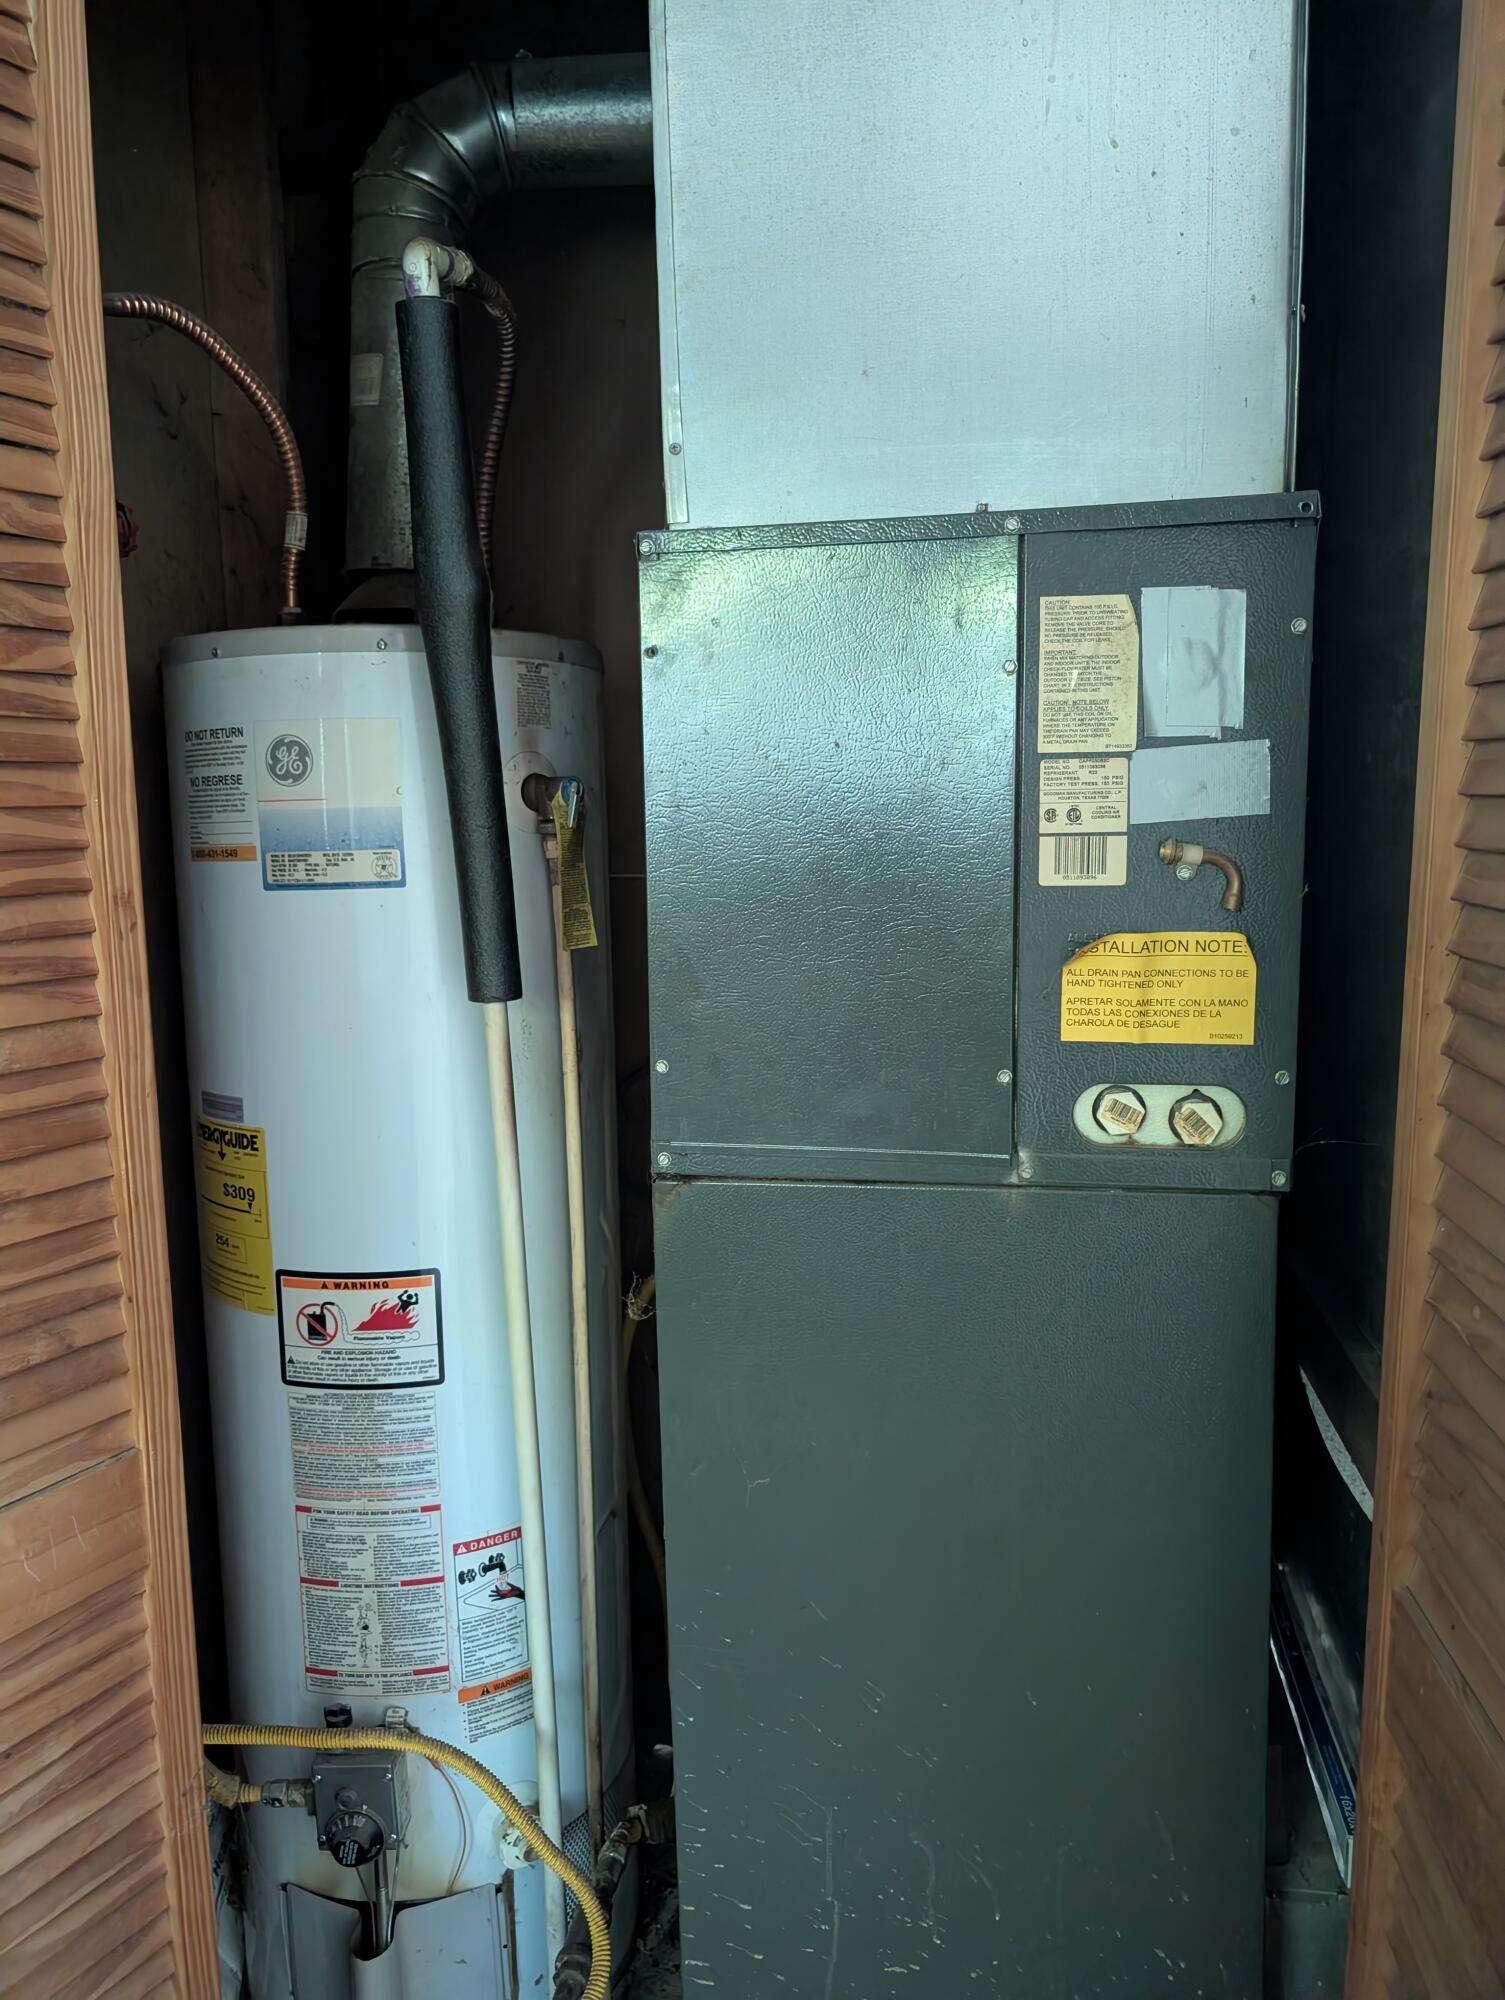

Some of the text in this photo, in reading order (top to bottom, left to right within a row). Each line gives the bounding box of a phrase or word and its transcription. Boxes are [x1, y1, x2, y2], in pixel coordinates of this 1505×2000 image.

[185, 727, 244, 742] DO NOT RETURN
[190, 774, 243, 788] NO REGRESE
[1083, 939, 1189, 955] STALLATION
[1196, 939, 1248, 954] NOTE:
[1066, 968, 1085, 977] ALL
[1088, 968, 1119, 977] DRAIN
[1122, 970, 1141, 978] PAN
[1143, 969, 1216, 978] CONNECTIONS
[1220, 969, 1232, 977] TO
[1067, 979, 1184, 989] HAND TIGHTENED ONLY
[1066, 997, 1248, 1008] APRETAR SOLAMENTE CON LA MANO
[1067, 1008, 1222, 1018] TODAS LAS CONEXIONES DE LA
[1066, 1019, 1181, 1029] CHAROLA DE DESAGUE
[223, 1182, 255, 1202] $309
[216, 1233, 229, 1248] 254
[334, 1282, 389, 1290] WARNING
[470, 1530, 519, 1551] DANGER
[496, 1574, 510, 1582] HOT
[492, 1672, 529, 1691] WARNING
